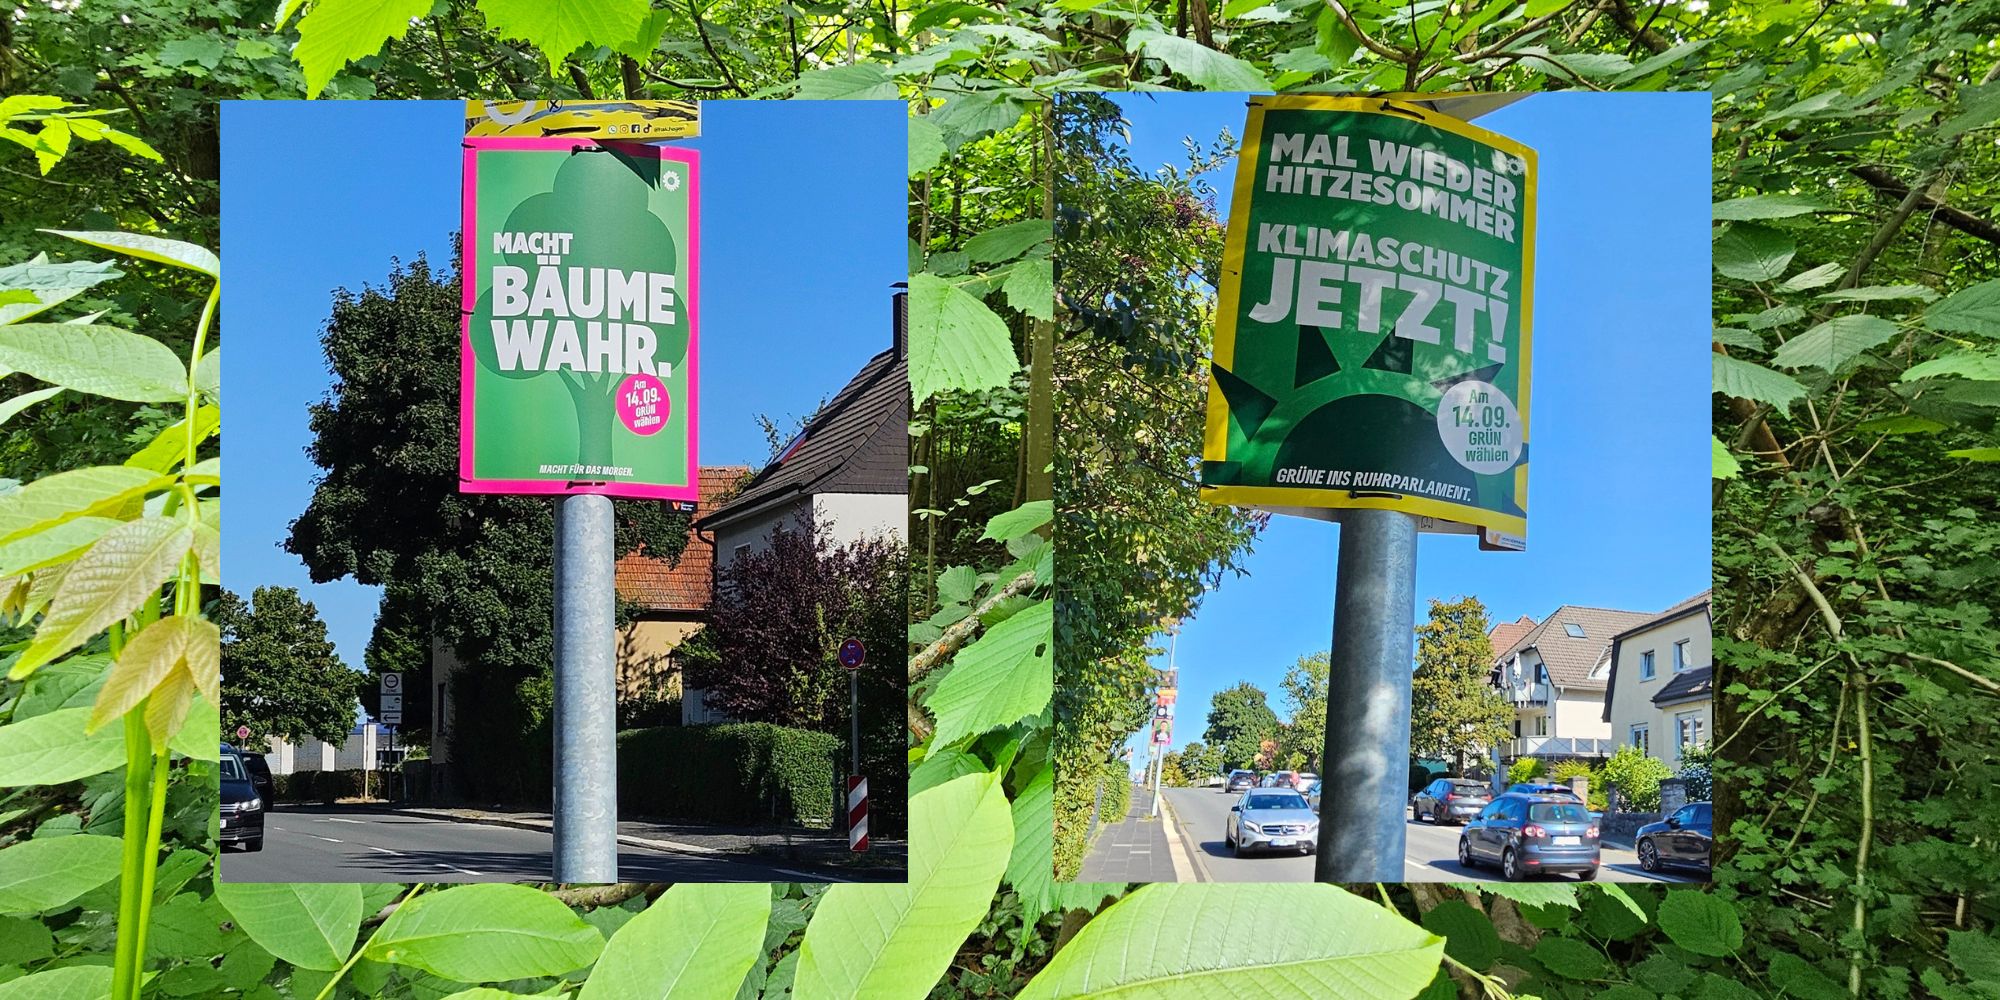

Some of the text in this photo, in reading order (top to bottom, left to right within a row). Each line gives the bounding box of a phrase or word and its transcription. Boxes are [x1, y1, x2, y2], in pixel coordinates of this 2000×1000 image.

[1270, 133, 1517, 213] MAL WIEDER
[1266, 165, 1515, 243] HITZESOMMER
[493, 232, 573, 254] MACHT
[1257, 222, 1509, 300] KLIMASCHUTZ
[492, 255, 676, 325] BÄUME
[1248, 257, 1509, 364] JETZT!
[490, 319, 672, 378] WAHR.
[634, 380, 646, 390] Am
[1469, 389, 1488, 403] Am
[625, 387, 661, 407] 14.09.
[635, 403, 656, 417] GRÜN
[1452, 405, 1510, 428] 14.09.
[634, 415, 661, 428] wählen
[1469, 428, 1501, 446] GRÜN
[1465, 447, 1508, 462] wählen
[539, 463, 634, 477] MACHT FÜR DAS MORGEN.
[1276, 466, 1472, 502] GRÜNE INS RUHRPARLAMENT.
